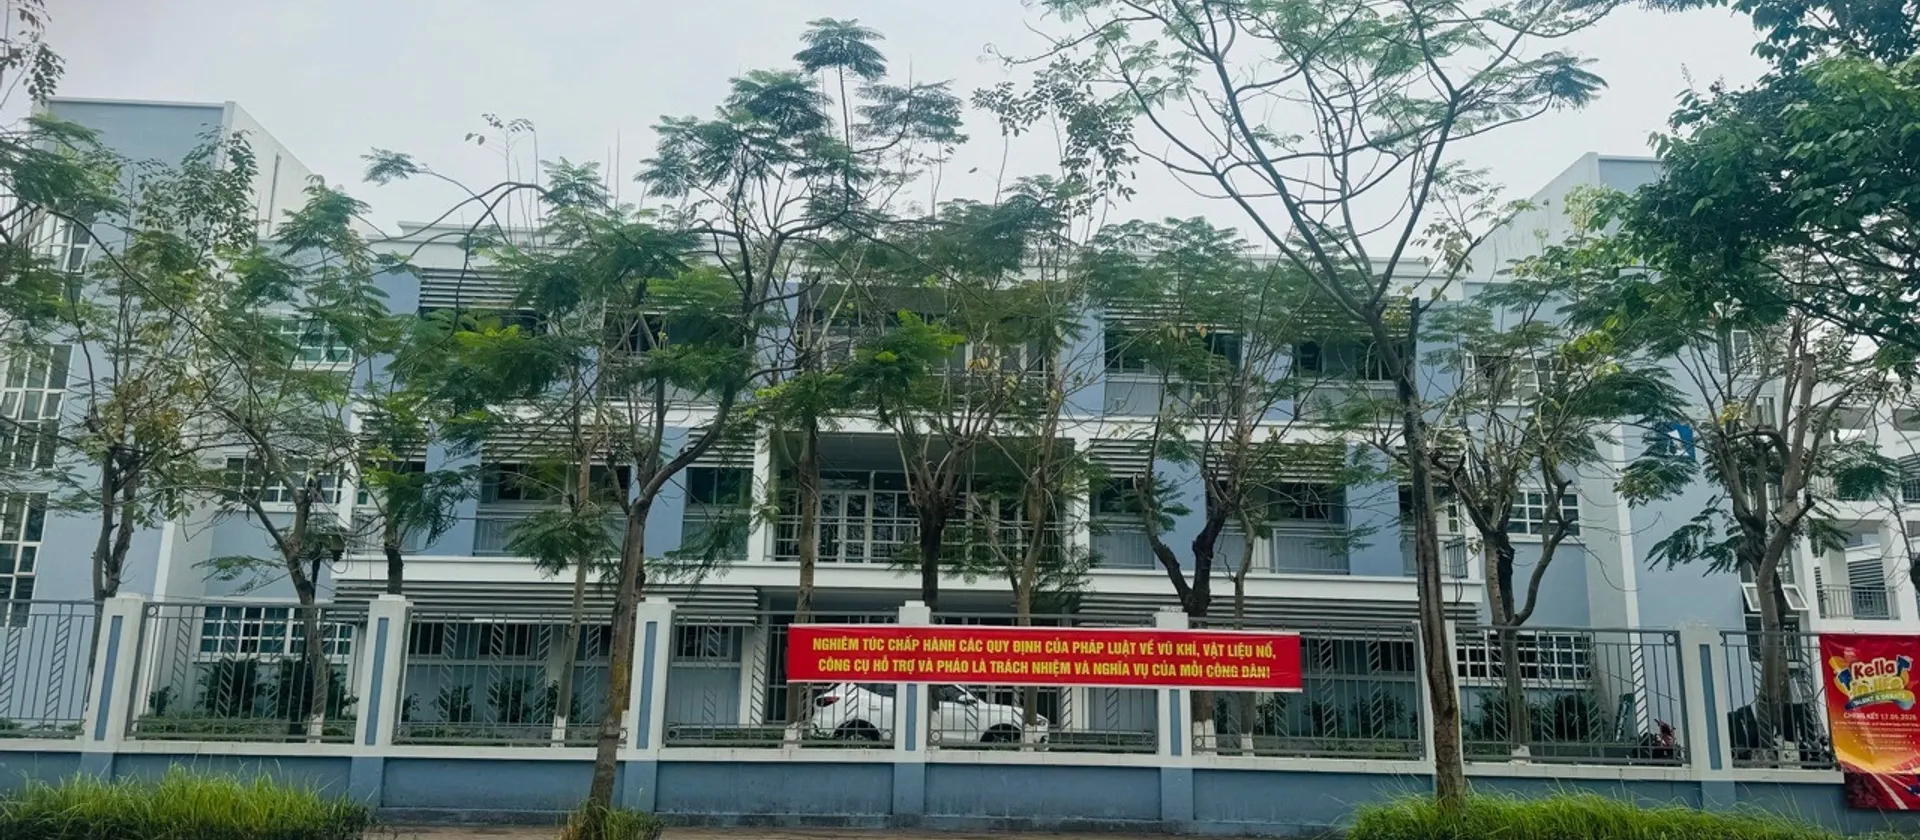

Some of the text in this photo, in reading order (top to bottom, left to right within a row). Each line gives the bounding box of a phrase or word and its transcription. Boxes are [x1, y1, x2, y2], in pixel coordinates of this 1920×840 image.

[812, 635, 1277, 660] NGHIÊM TÚC CHẤP HÀNH CÁC QUY ĐỊNH CỦA PHÁP LUẬT VỀ VŨ KHÍ, VẬT LIỆU NỔ,
[818, 656, 851, 672] CÔNG
[853, 659, 870, 675] CỤ
[892, 659, 916, 675] TRỢ
[918, 657, 934, 673] VÀ
[936, 657, 969, 673] PHÁO
[971, 658, 987, 674] LÀ
[989, 659, 1028, 674] TRÁCH
[1031, 660, 1071, 678] NHIỆM
[1073, 660, 1090, 675] VÀ
[1092, 661, 1130, 677] NGHĨA
[1132, 663, 1149, 679] VỤ
[1151, 660, 1177, 677] CỦA
[1205, 662, 1239, 678] CÔNG
[1241, 662, 1271, 679] DÂN!
[1853, 659, 1896, 680] Kella
